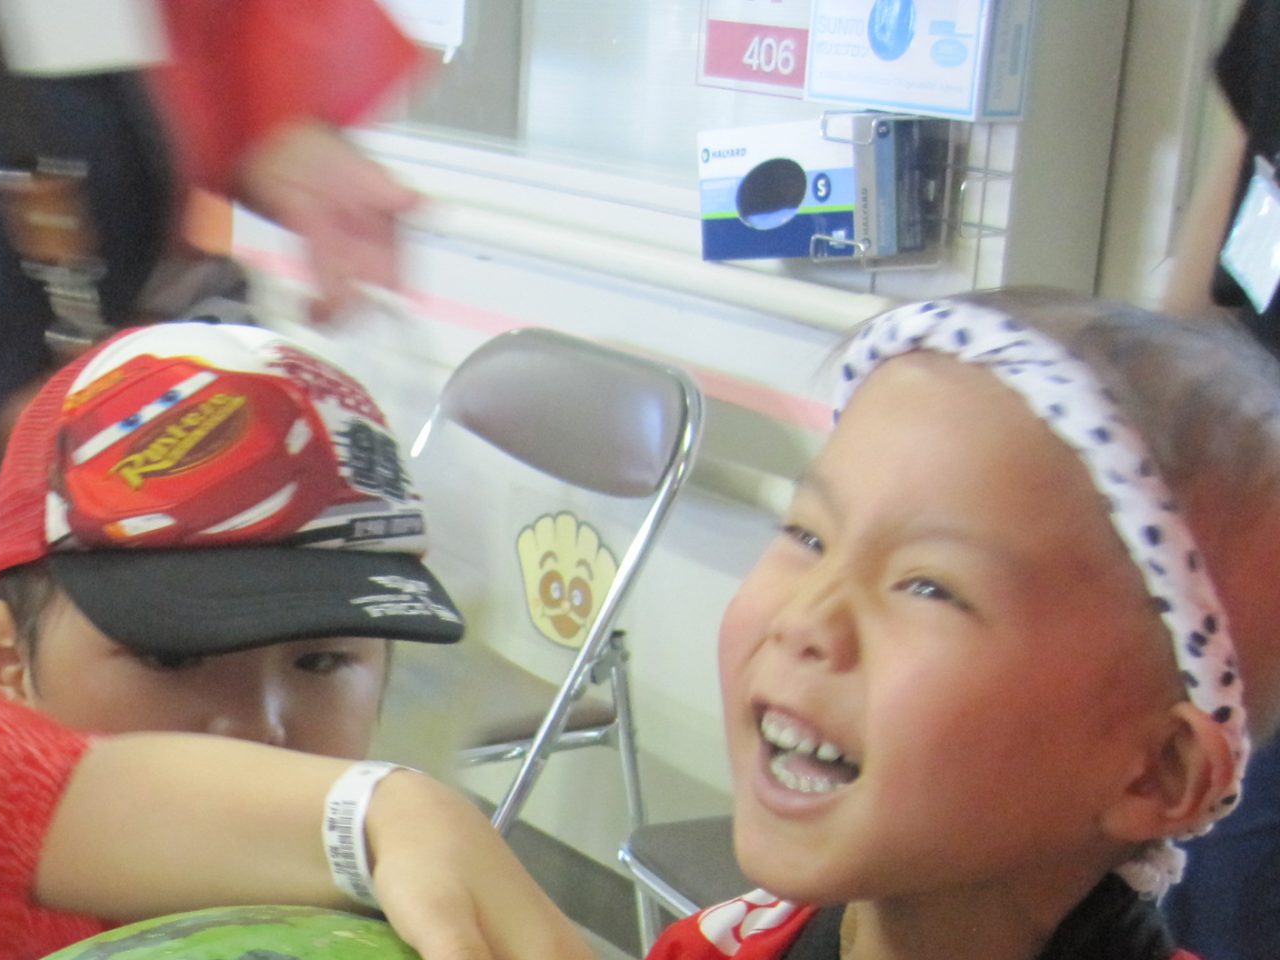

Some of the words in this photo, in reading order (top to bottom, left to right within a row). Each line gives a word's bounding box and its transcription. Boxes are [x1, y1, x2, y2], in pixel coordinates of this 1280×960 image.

[742, 35, 796, 75] 406
[712, 147, 747, 158] HALYARD
[816, 179, 827, 197] S
